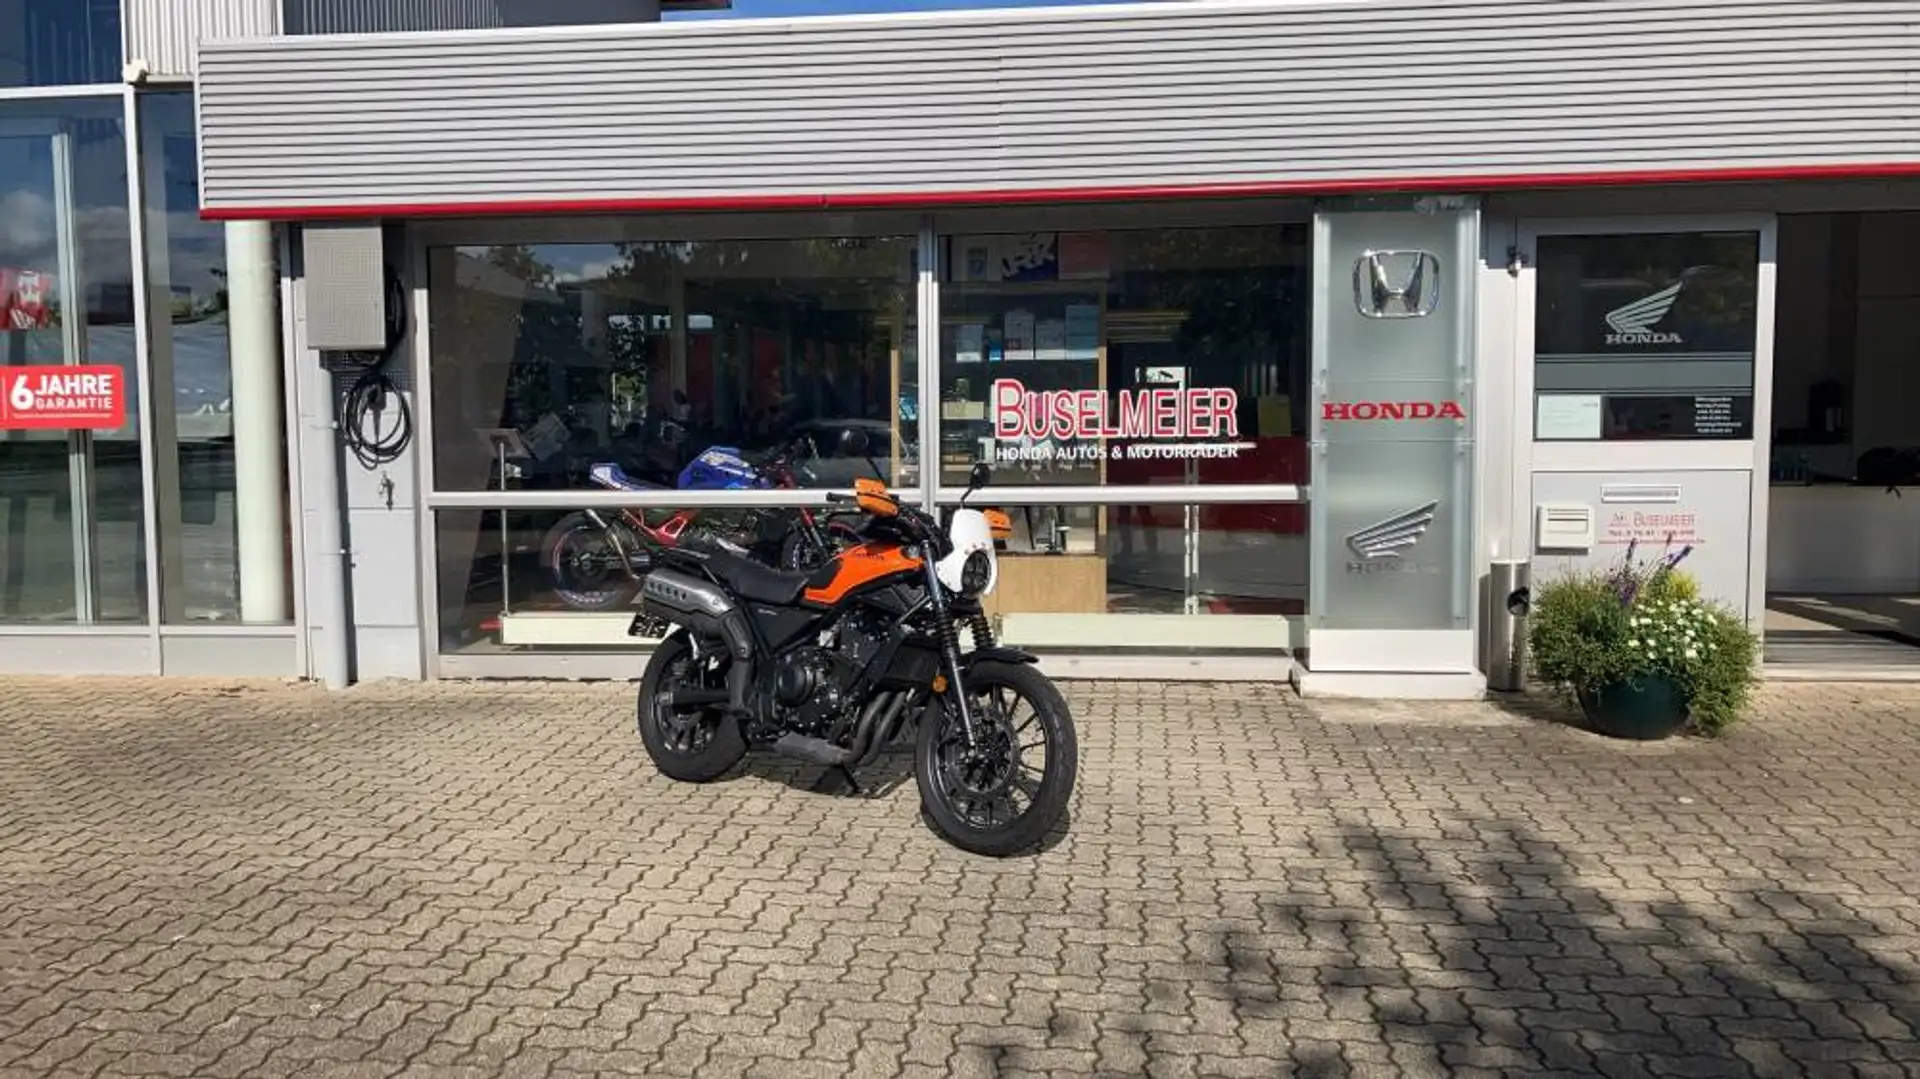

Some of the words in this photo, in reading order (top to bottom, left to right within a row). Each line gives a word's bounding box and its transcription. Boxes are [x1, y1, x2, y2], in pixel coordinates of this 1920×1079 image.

[1605, 333, 1682, 344] HONDA
[11, 374, 34, 410] 6
[36, 374, 115, 395] JAHRE
[35, 397, 113, 409] GARANTIE
[994, 378, 1238, 439] BUSELMEIER
[1321, 402, 1466, 420] HONDA
[996, 446, 1051, 460] HONDA
[1056, 446, 1106, 460] AUTOS
[1111, 445, 1122, 459] &
